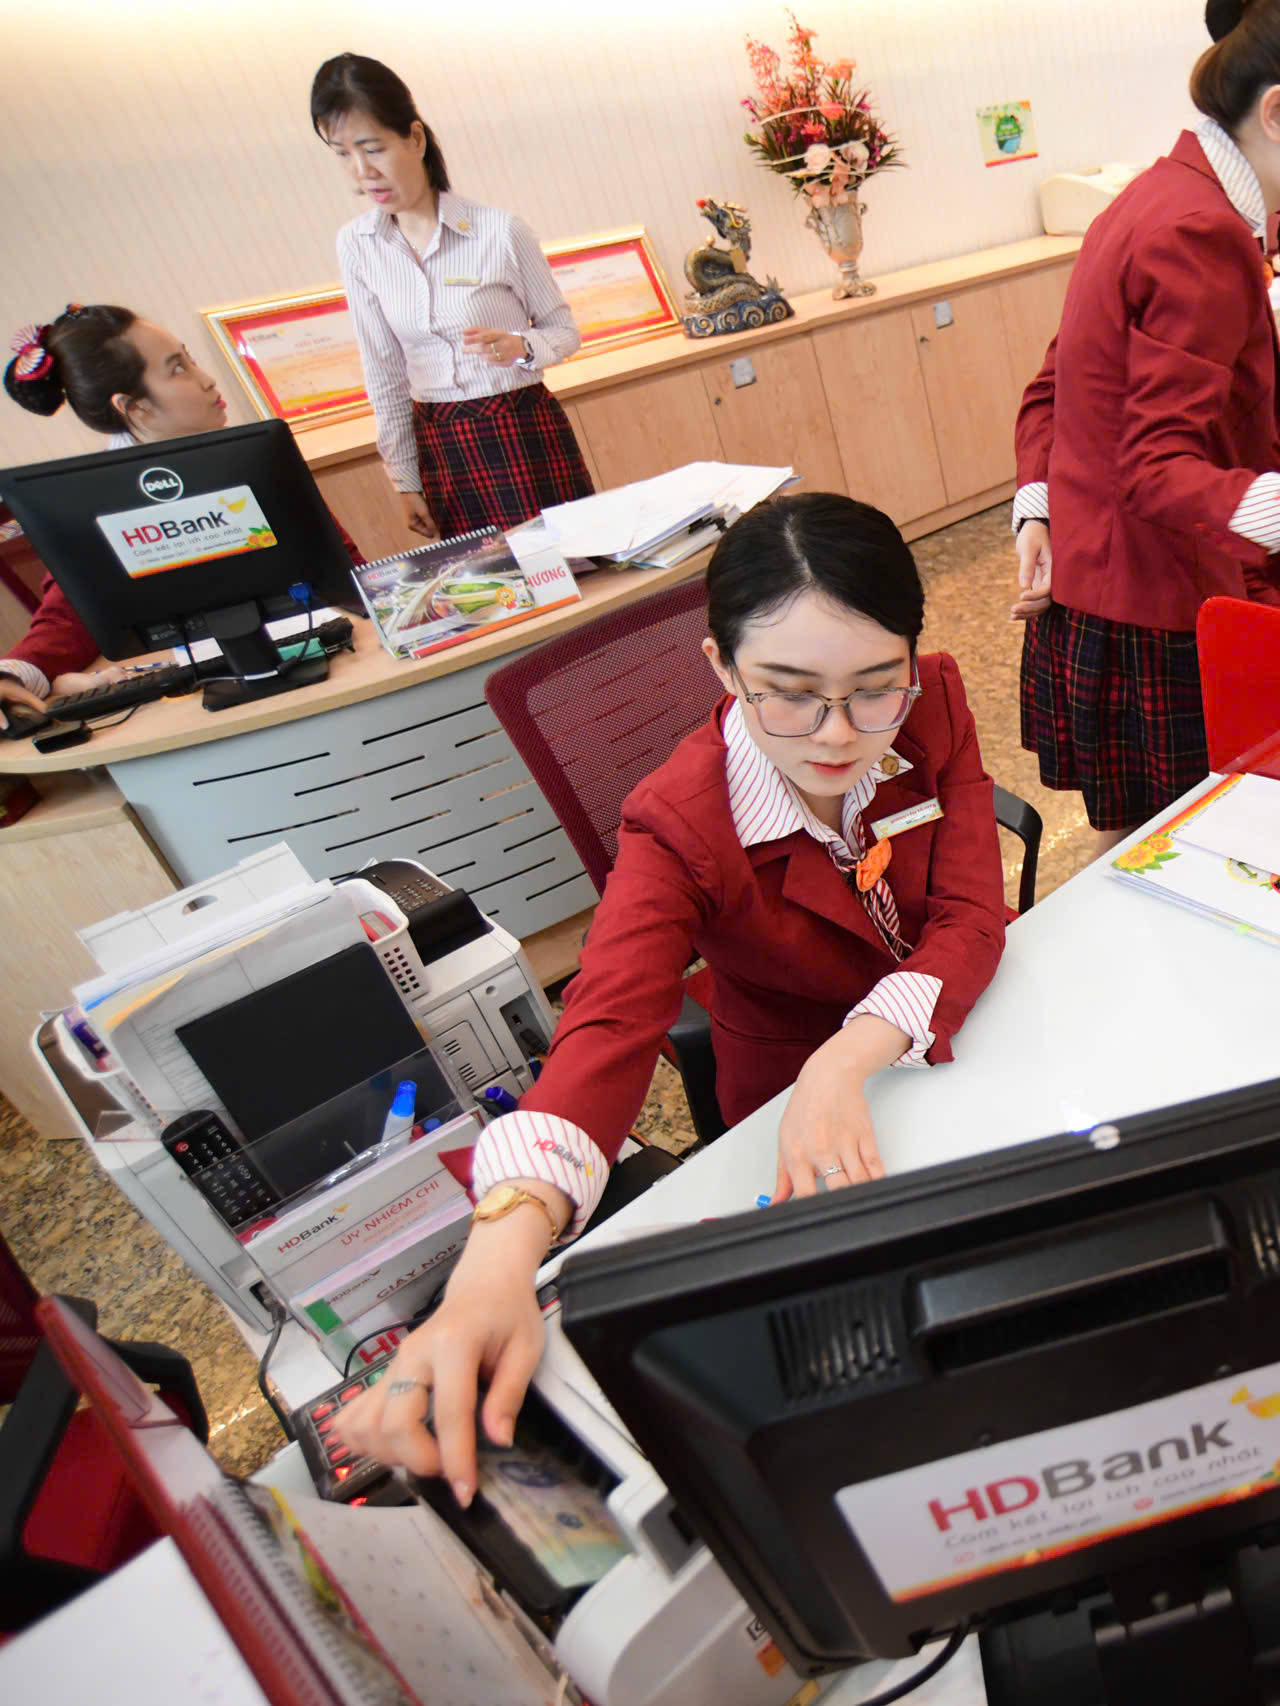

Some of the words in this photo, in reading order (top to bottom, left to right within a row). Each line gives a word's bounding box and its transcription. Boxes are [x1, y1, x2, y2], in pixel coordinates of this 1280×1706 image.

[145, 477, 179, 492] DELL
[122, 511, 229, 548] HDBank
[532, 1136, 585, 1172] HDBank
[415, 1180, 440, 1199] CHI
[277, 1215, 339, 1254] HDBank
[927, 1419, 1235, 1533] HDBank
